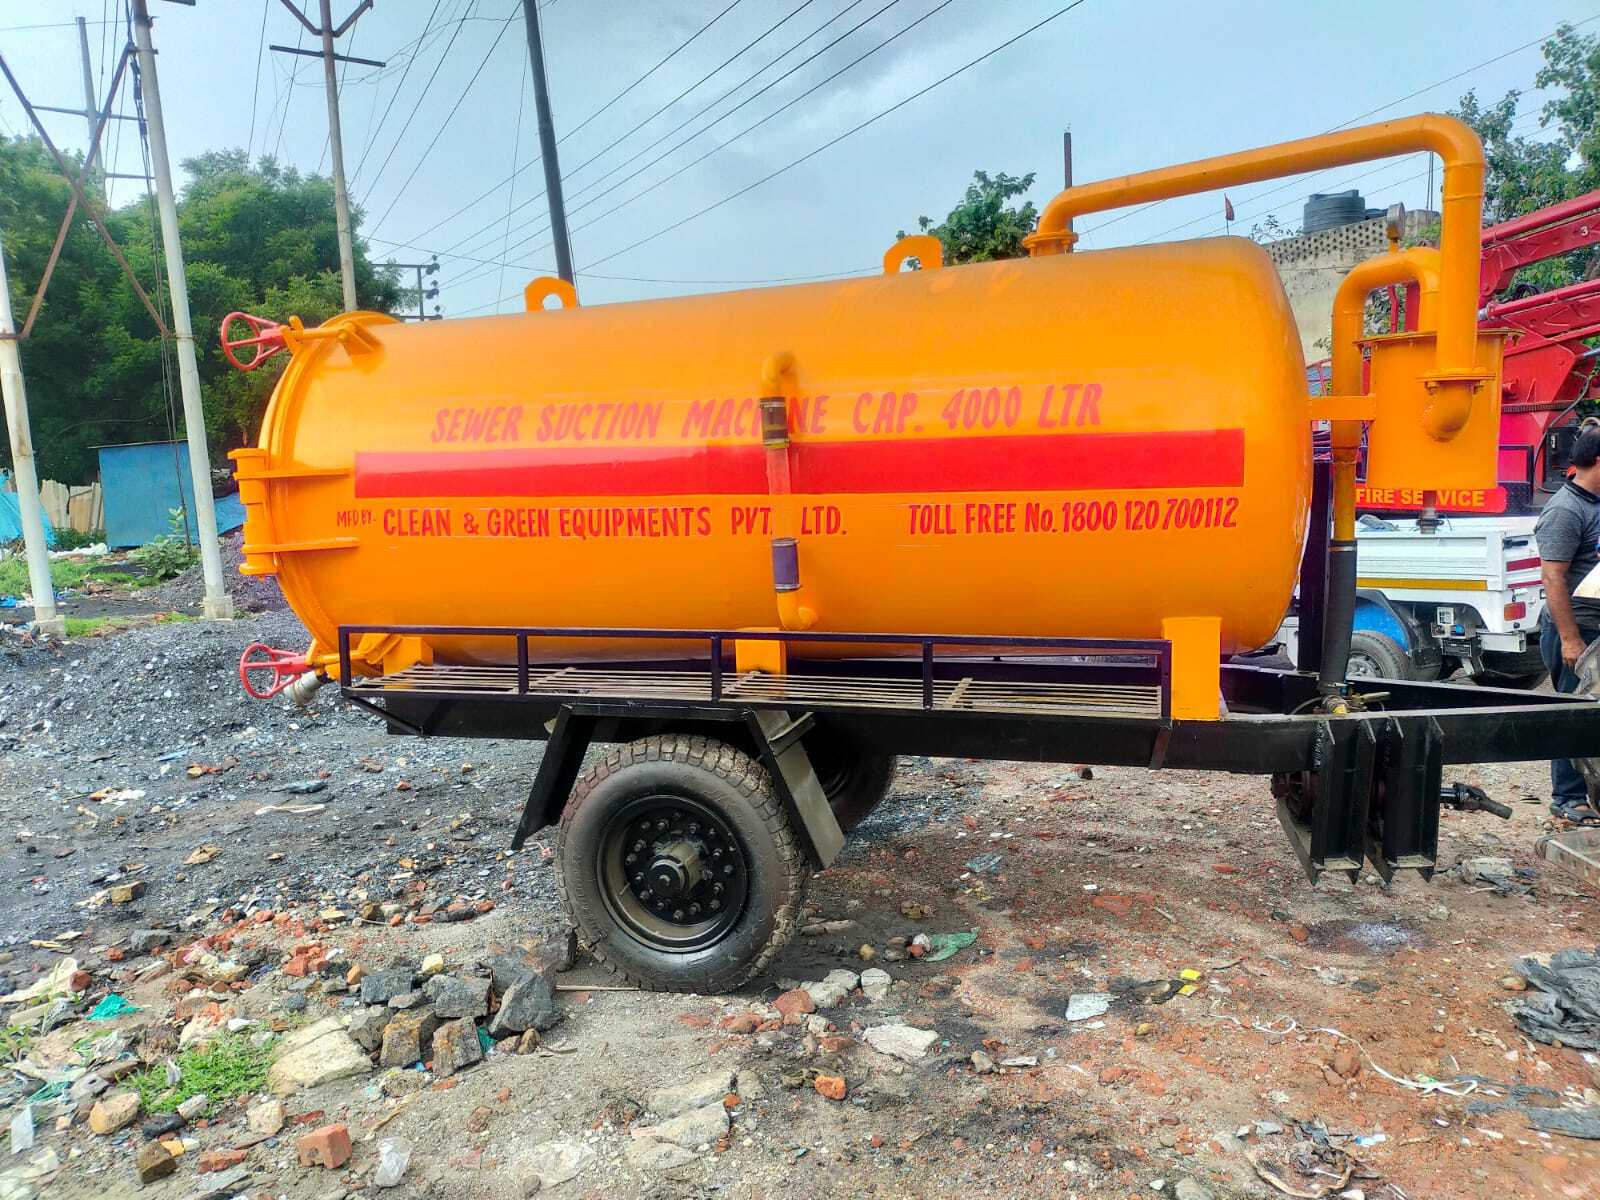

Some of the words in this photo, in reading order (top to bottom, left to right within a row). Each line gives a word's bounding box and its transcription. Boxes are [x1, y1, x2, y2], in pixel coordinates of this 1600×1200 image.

[431, 406, 524, 443] SEWER
[536, 401, 664, 441] SUCTION
[681, 394, 830, 439] MACNE
[852, 391, 924, 434] CAP.
[942, 386, 1022, 430] 4000
[1038, 383, 1103, 428] LTR
[1355, 489, 1395, 504] FIRE
[1400, 490, 1486, 507] SEVICE
[383, 508, 451, 537] CLEAN
[463, 511, 480, 535] &
[487, 507, 550, 538] GREEN
[559, 506, 711, 540] EQUIPMENTS
[801, 505, 847, 535] LTD.
[908, 504, 957, 535] TOLL
[966, 502, 1016, 534] FREE
[1024, 502, 1058, 533] No.
[1062, 501, 1118, 532] 1800
